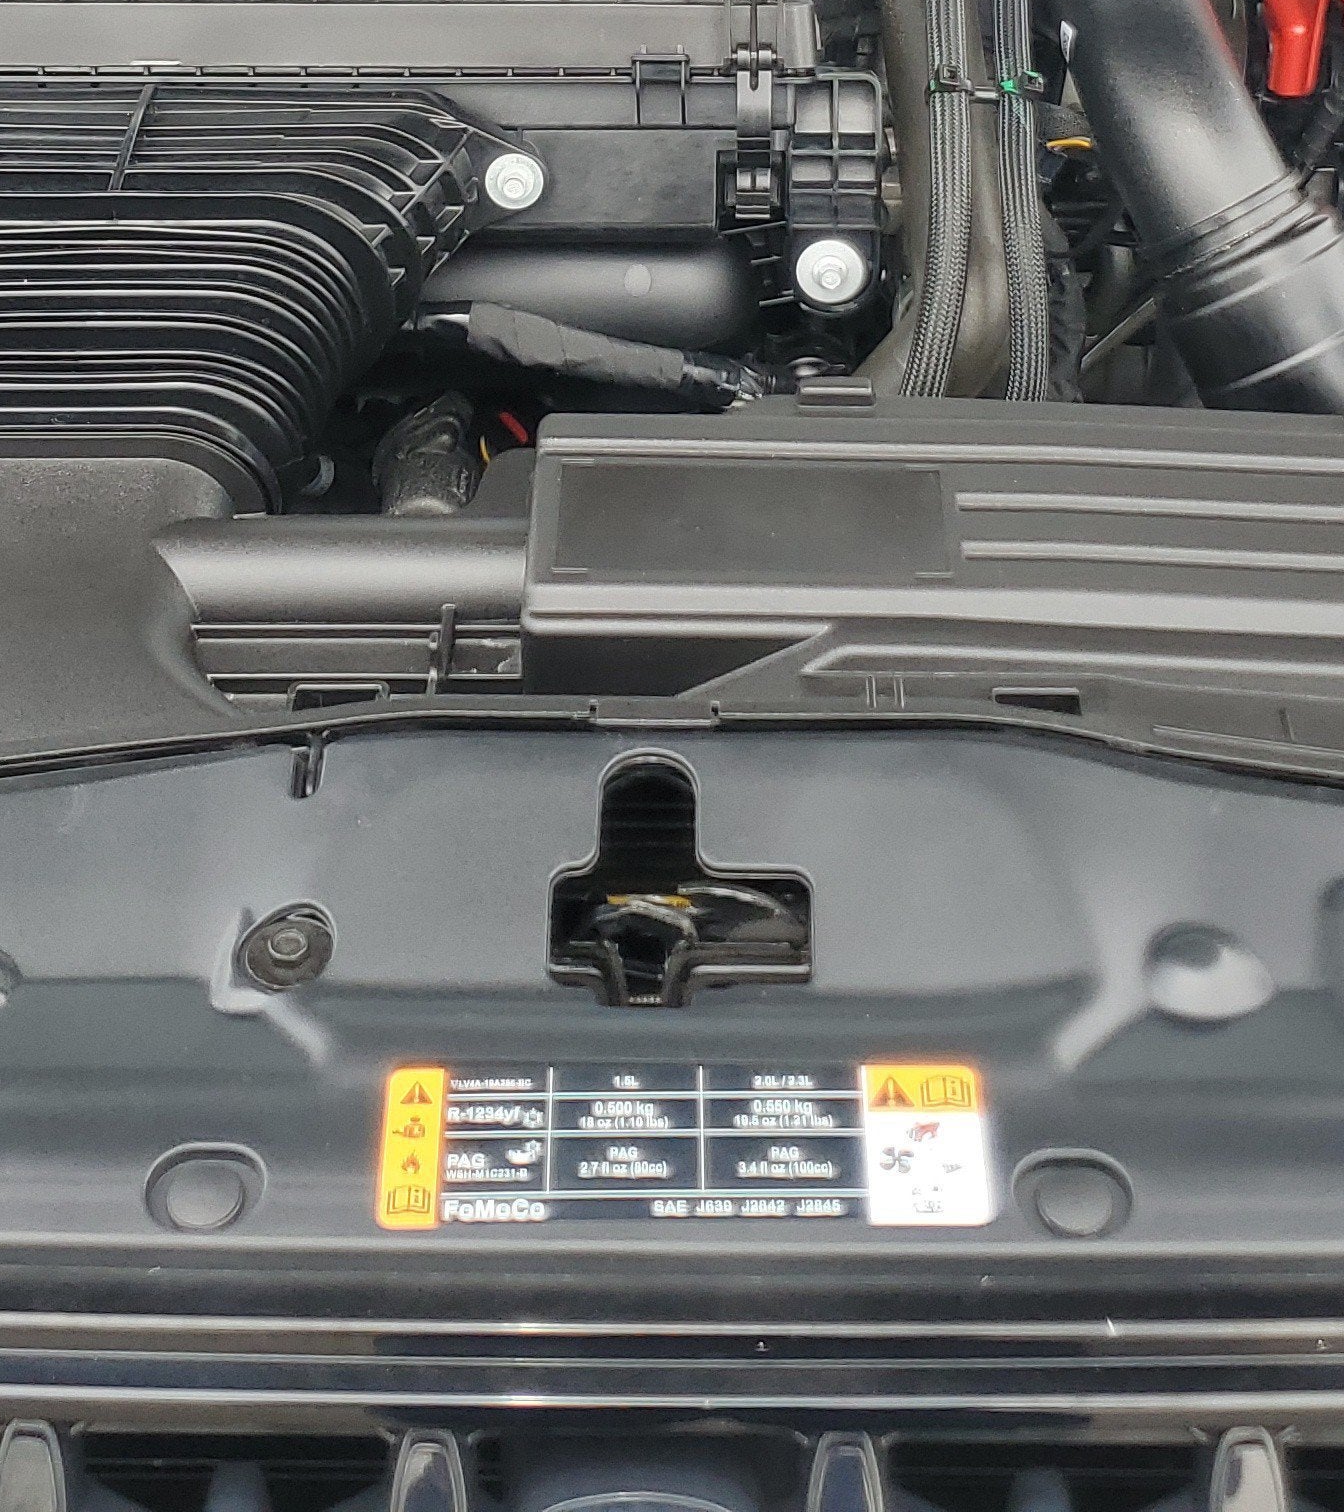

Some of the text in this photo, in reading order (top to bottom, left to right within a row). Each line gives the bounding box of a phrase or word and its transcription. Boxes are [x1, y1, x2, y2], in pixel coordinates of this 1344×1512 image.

[446, 1106, 522, 1125] R-1234yf
[594, 1100, 655, 1117] 0.500 kg
[794, 1099, 813, 1116] kg
[446, 1152, 486, 1169] PAG
[609, 1146, 639, 1160] PAG
[770, 1146, 800, 1160] PAG
[443, 1198, 546, 1221] FoMoCo
[653, 1199, 688, 1214] SAE
